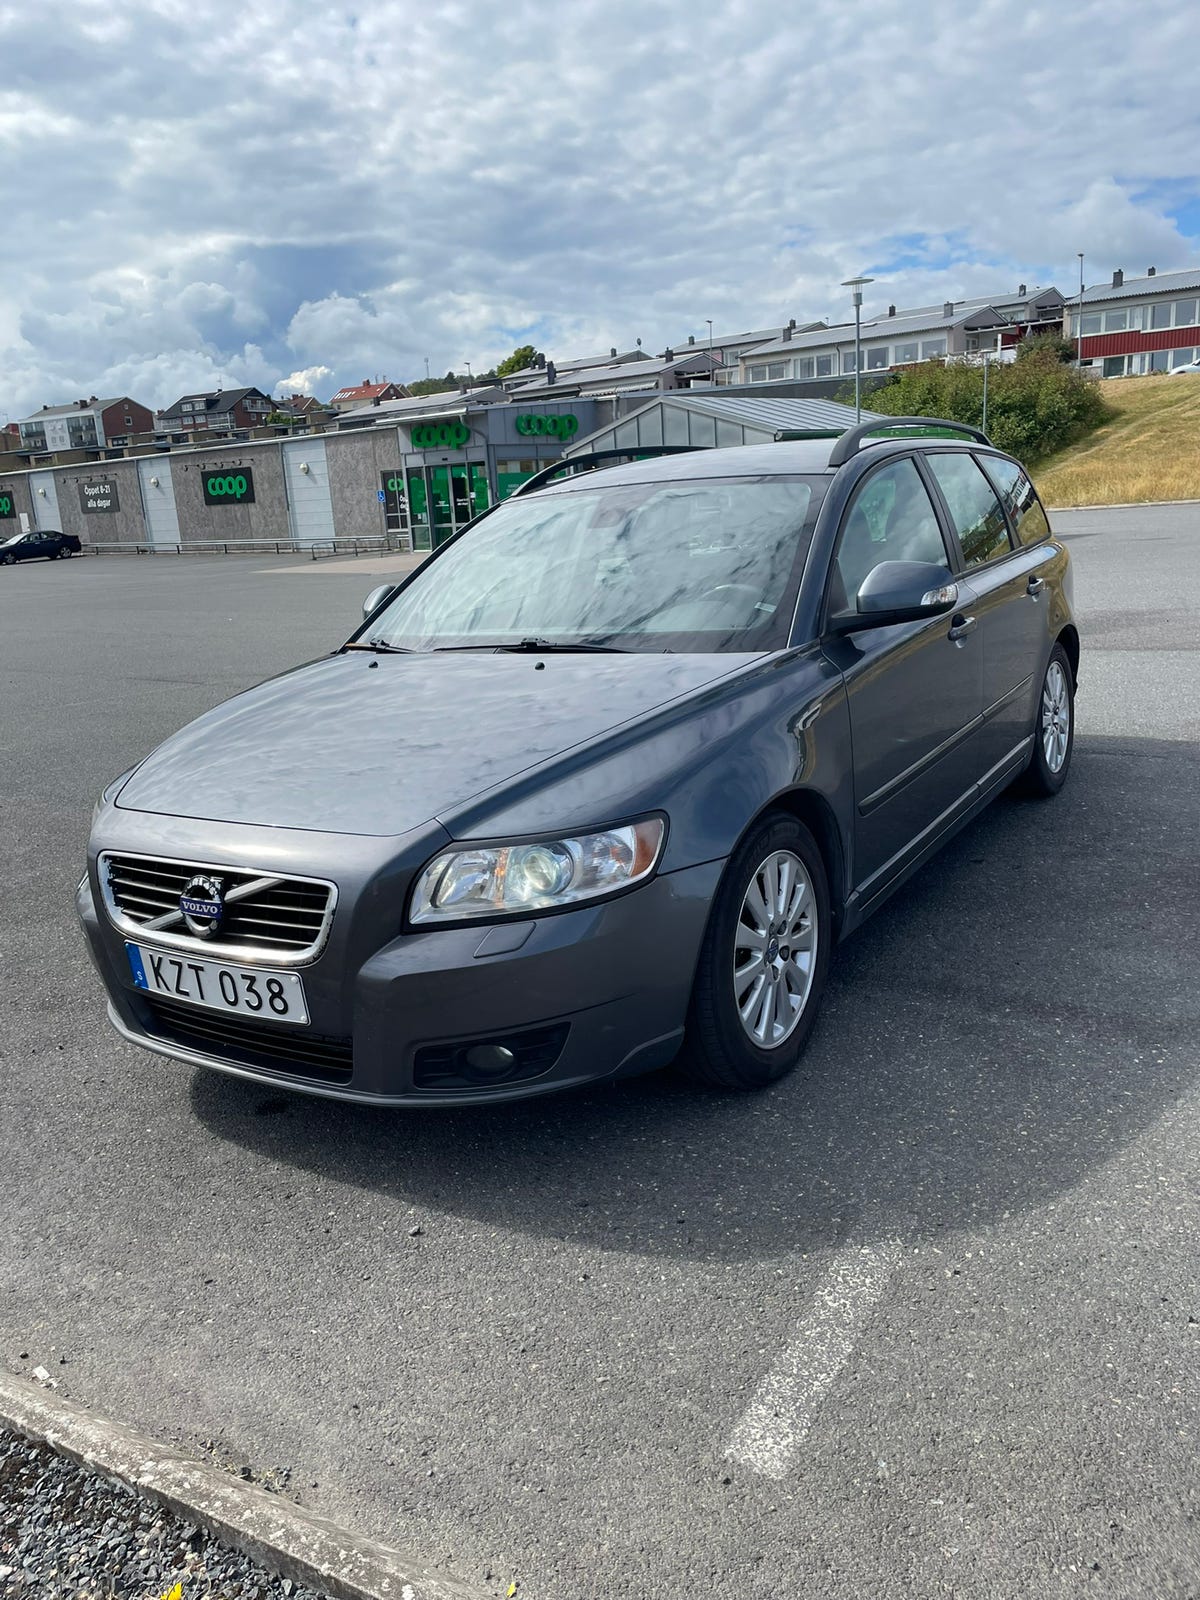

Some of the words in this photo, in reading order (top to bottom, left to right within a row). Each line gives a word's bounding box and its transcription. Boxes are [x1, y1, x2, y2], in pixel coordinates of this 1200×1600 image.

[411, 422, 470, 450] coop
[516, 414, 579, 441] coop
[84, 485, 100, 497] Öppet
[206, 474, 248, 499] coop
[87, 498, 97, 508] alla
[97, 498, 111, 509] dagar
[182, 900, 218, 915] VOLVO
[136, 970, 144, 981] S
[149, 953, 206, 1001] KZT
[218, 970, 289, 1015] 038
